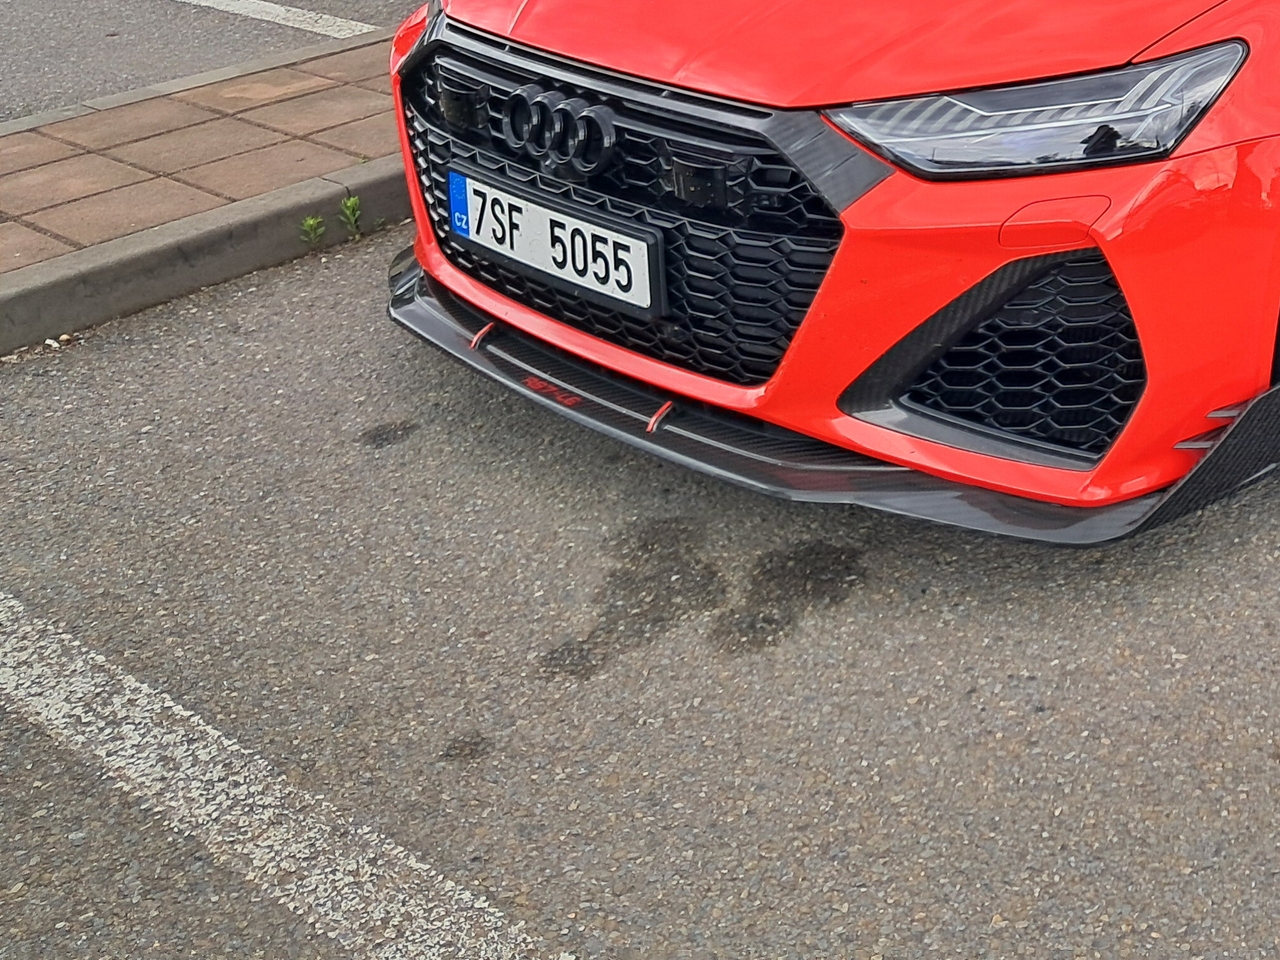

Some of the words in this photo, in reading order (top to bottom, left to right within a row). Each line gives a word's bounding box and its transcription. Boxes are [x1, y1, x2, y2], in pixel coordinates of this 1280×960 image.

[454, 211, 468, 229] CZ
[472, 187, 523, 252] 7SF
[549, 217, 633, 294] 5055
